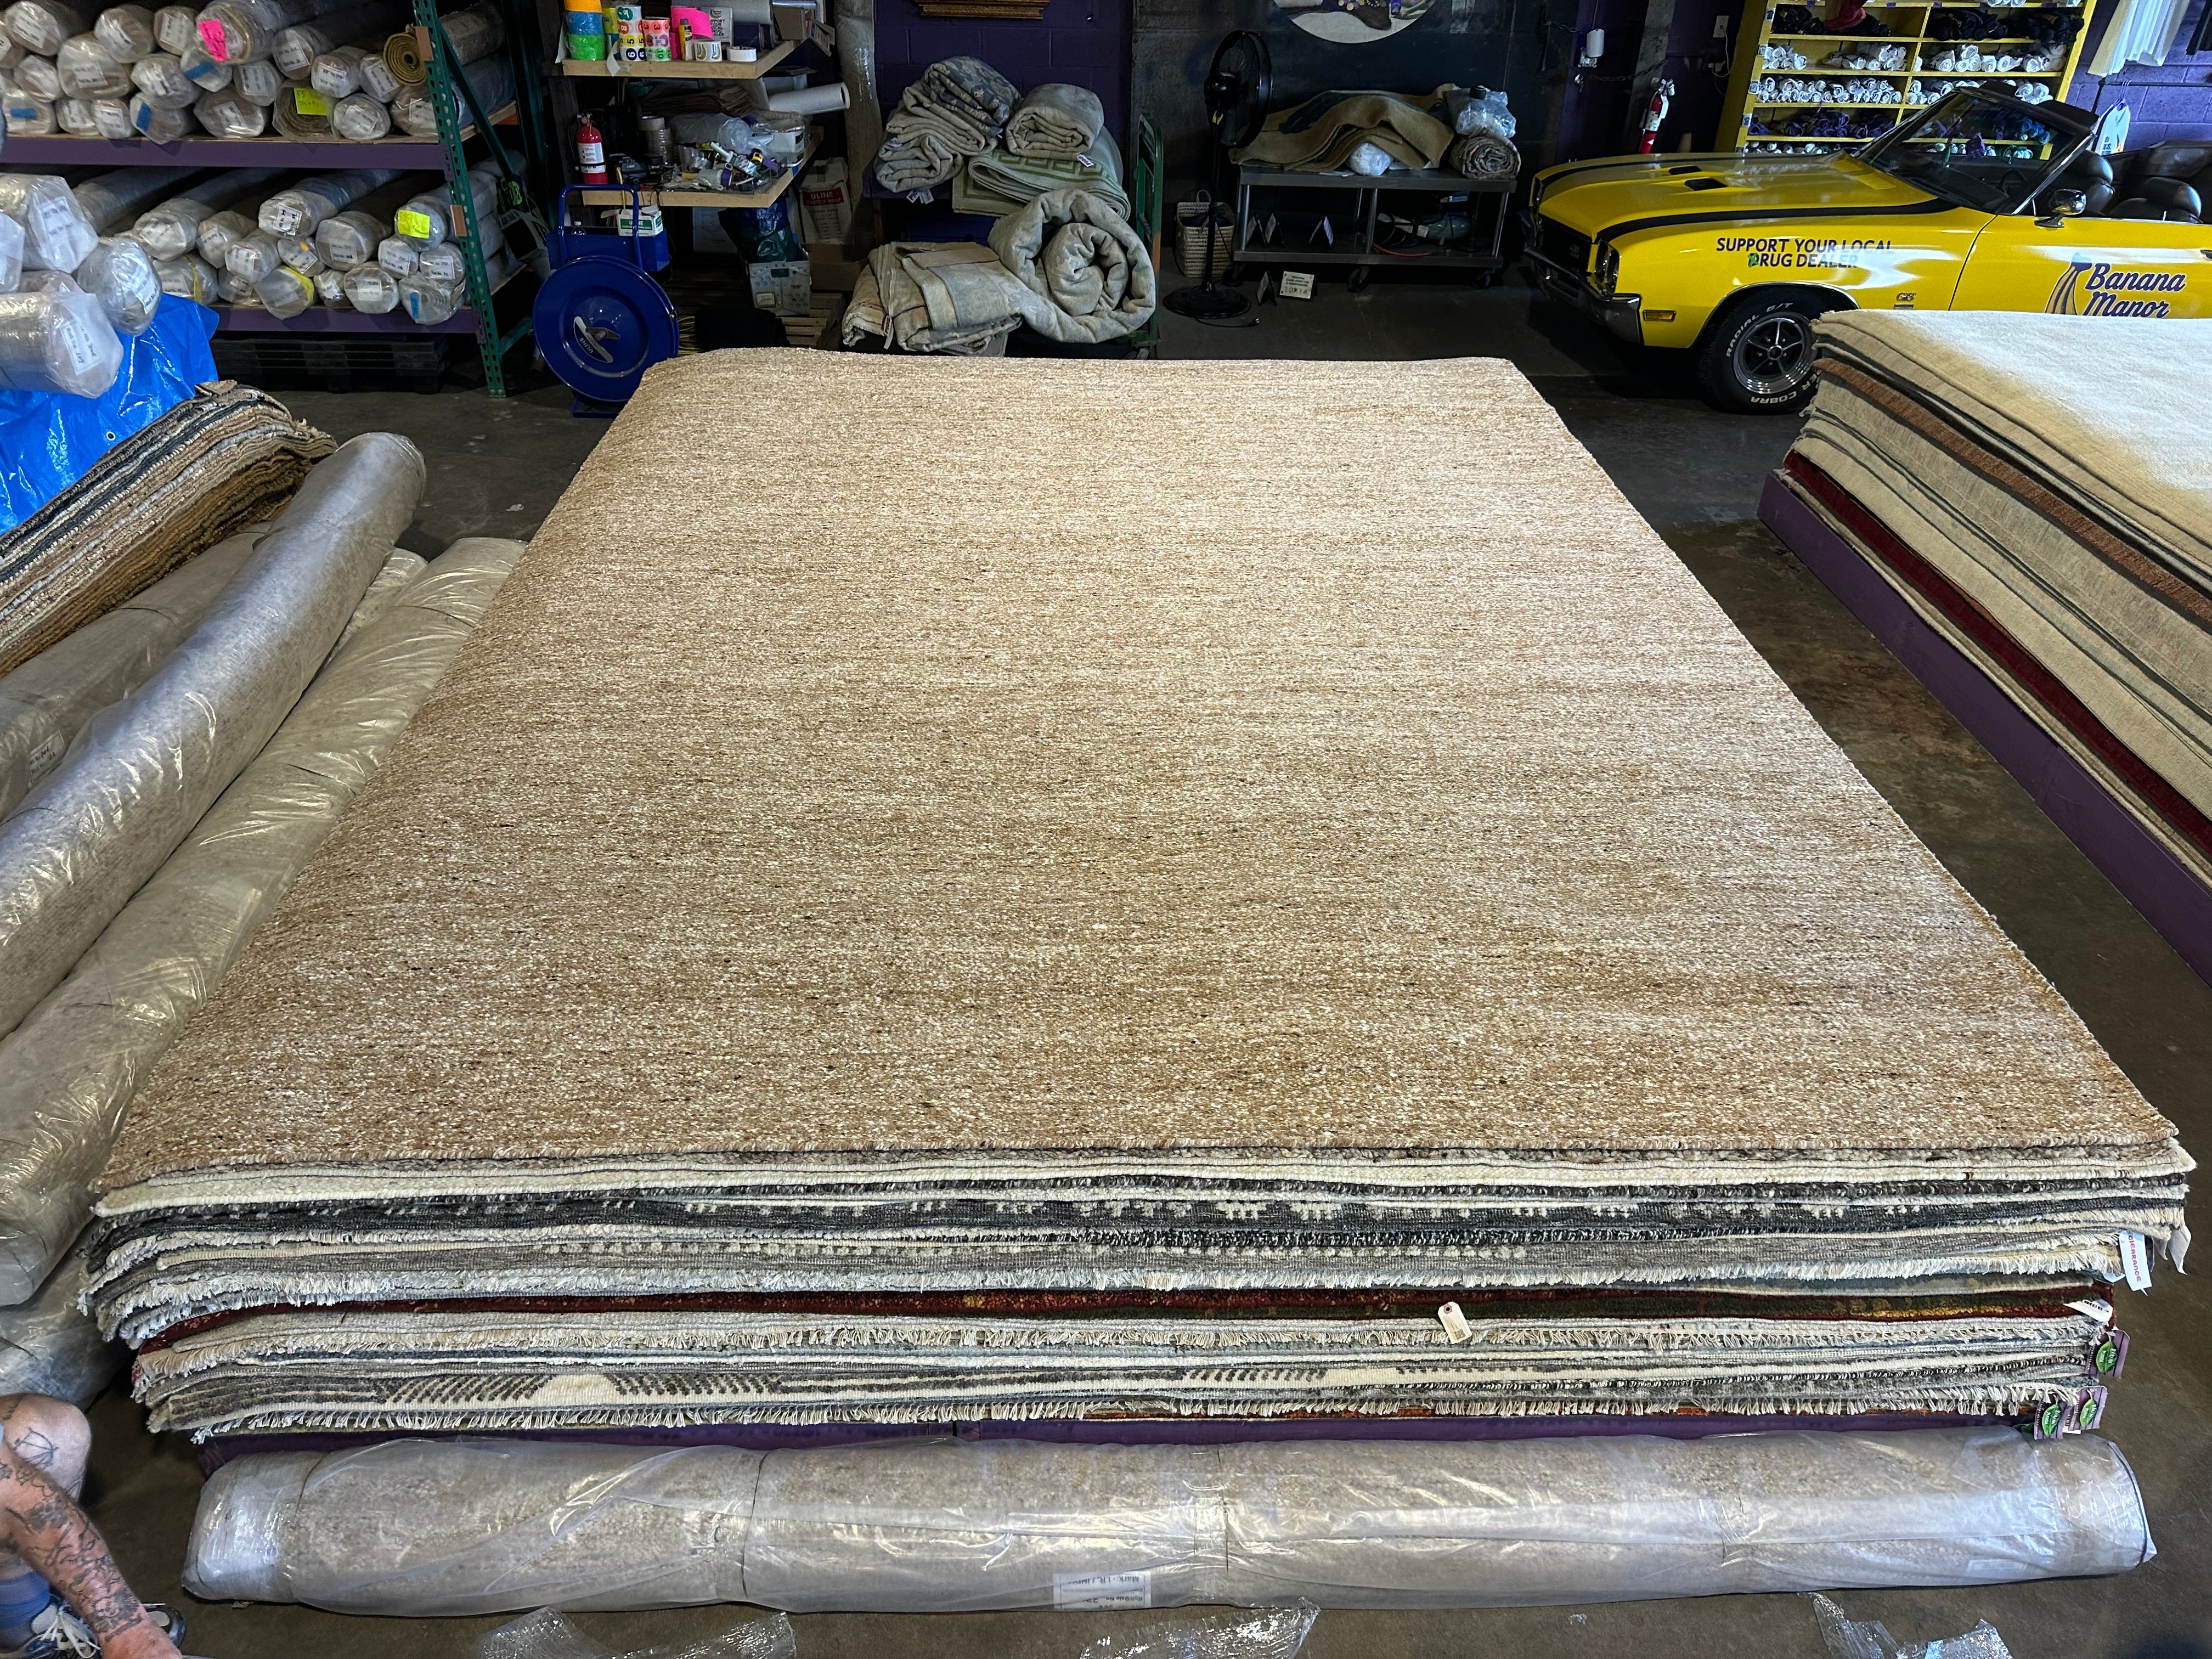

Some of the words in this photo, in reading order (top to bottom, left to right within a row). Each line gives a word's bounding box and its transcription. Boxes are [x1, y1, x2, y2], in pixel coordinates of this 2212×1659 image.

[810, 191, 834, 199] ULINE
[1716, 238, 1790, 252] SUPPORT
[1795, 239, 1838, 253] YOUR
[1839, 240, 1893, 254] LOCAL
[1748, 253, 1792, 268] DRUG
[1796, 253, 1859, 268] DEALER
[2085, 263, 2186, 292] Banana
[2083, 291, 2169, 318] Manor
[1726, 314, 1759, 357] RADIAL
[579, 337, 594, 354] ULINE
[1750, 391, 1797, 404] COBRA
